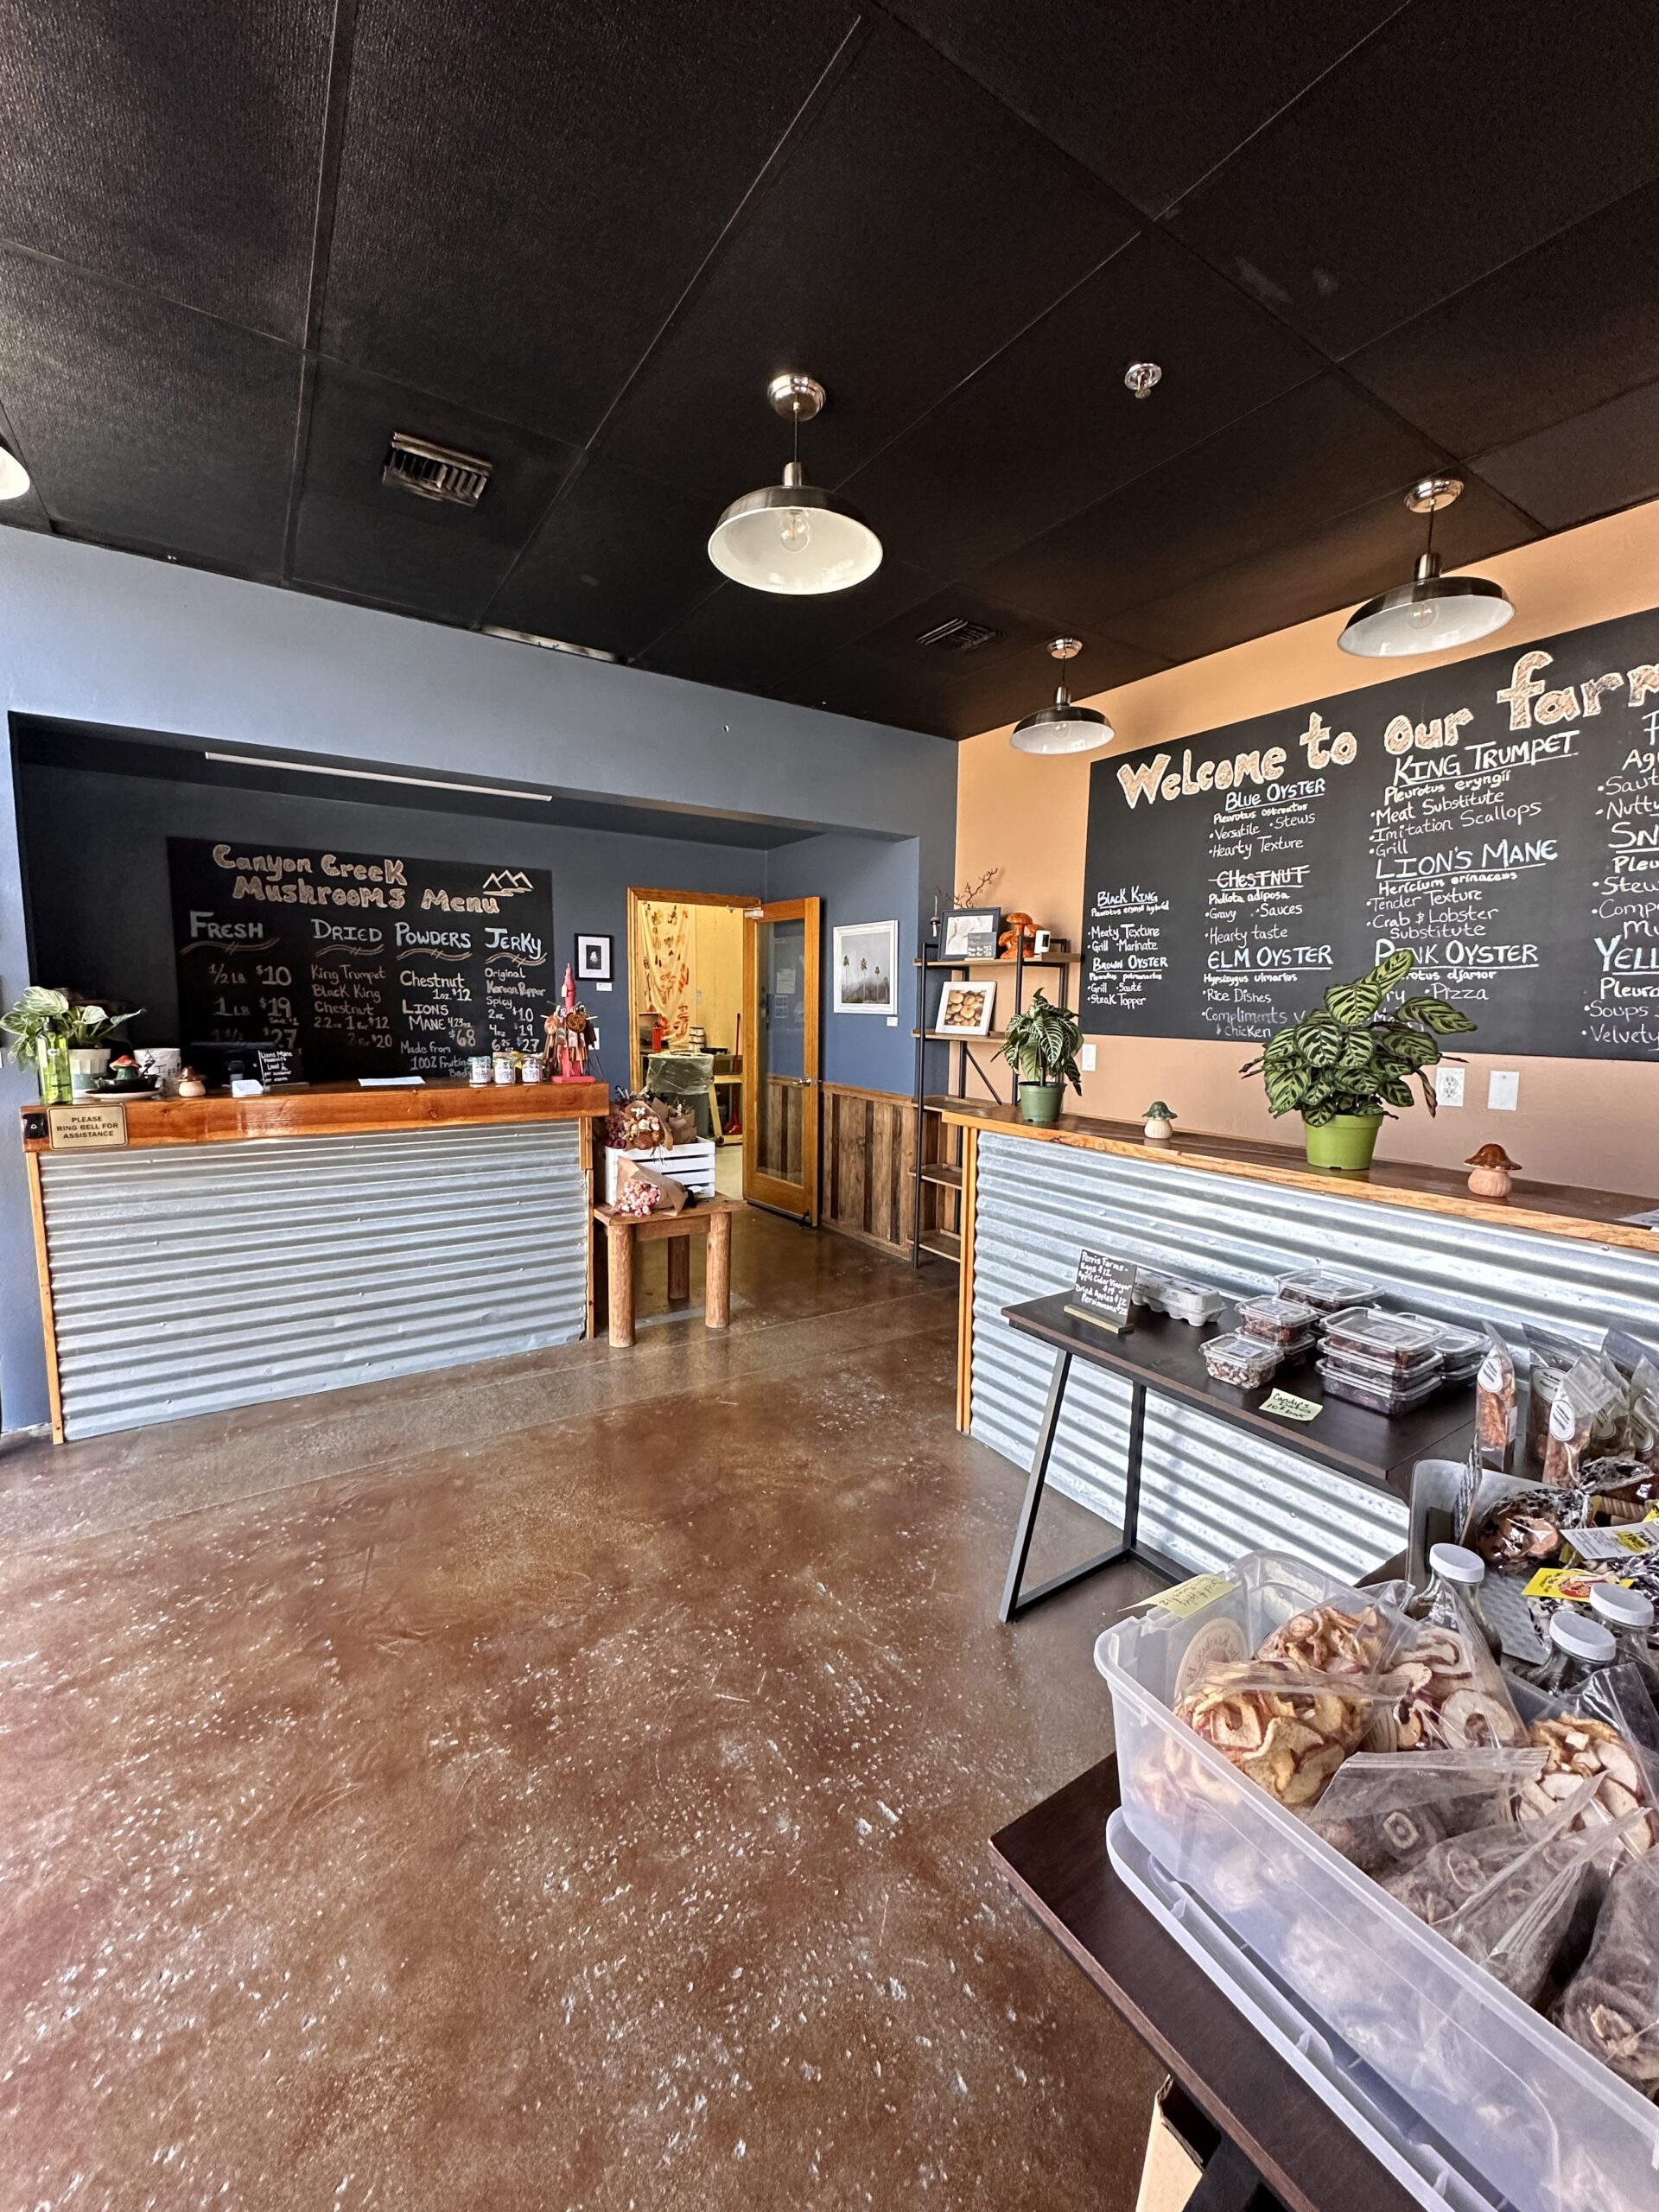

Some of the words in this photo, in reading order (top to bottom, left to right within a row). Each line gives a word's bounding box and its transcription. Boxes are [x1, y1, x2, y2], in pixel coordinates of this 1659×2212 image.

[1116, 747, 1287, 810] Welcome
[1299, 711, 1357, 769] to
[1384, 708, 1474, 755] Our
[1393, 754, 1461, 787] KING
[1465, 730, 1580, 770] TRUMPET
[1267, 778, 1325, 802] OYSTER
[1384, 784, 1445, 806] Pleurotus
[1376, 803, 1415, 826] Meat
[1422, 790, 1504, 815] Substitute
[1274, 813, 1315, 830] Stews
[1372, 817, 1453, 842] Imitation
[1460, 801, 1542, 827] Scallops
[1215, 823, 1261, 841] Versatile
[1213, 840, 1252, 861] Hearty
[1257, 835, 1304, 853] Texture
[1376, 839, 1408, 857] Grill
[213, 843, 313, 881] Canyon
[1376, 845, 1473, 879] LION'S
[1482, 838, 1558, 868] MANE
[421, 888, 500, 913] Menu
[1131, 885, 1158, 902] KING
[1247, 888, 1290, 903] adiposa
[1370, 895, 1422, 912] Tender
[1422, 887, 1483, 906] Texture
[1210, 909, 1236, 922] Gravy
[1259, 903, 1303, 918] Sauces
[1372, 912, 1410, 929] Crab
[1429, 906, 1499, 924] Lobster
[190, 910, 264, 938] FRESH
[311, 918, 382, 942] DRIED
[1091, 925, 1119, 940] Meaty
[1121, 924, 1160, 939] Texture
[1390, 922, 1487, 939] Substitute
[395, 921, 471, 949] POWDERS
[485, 927, 542, 960] JERKY
[1210, 926, 1248, 949] Hearty
[1251, 924, 1288, 940] taste
[1092, 940, 1109, 953] Grill
[1118, 938, 1158, 952] Marinate
[1375, 938, 1439, 967] PNK
[1446, 939, 1539, 963] OYSTER
[1128, 955, 1168, 969] OYSTER
[1207, 947, 1251, 969] ELM
[1256, 944, 1334, 967] OYSTER
[207, 963, 230, 984] 1/2
[256, 964, 292, 986] $10
[311, 963, 339, 985] King
[340, 964, 387, 984] Trumpet
[400, 969, 466, 988] Chestnut
[485, 967, 526, 982] Original
[353, 984, 381, 1002] King
[452, 988, 472, 1001] $12
[486, 980, 518, 995] Korean
[518, 982, 546, 997] Pepper
[1091, 982, 1107, 993] Grill
[1206, 988, 1230, 1001] Rice
[1234, 988, 1272, 1003] Dishes
[1431, 982, 1489, 1000] Pizza
[259, 996, 292, 1018] $19
[315, 1000, 374, 1015] Chestnut
[486, 995, 512, 1009] Spicy
[1117, 993, 1147, 1009] Topper
[488, 1008, 505, 1020] 2oz
[512, 1006, 534, 1022] $10
[1205, 1007, 1287, 1026] Compliments
[1589, 1001, 1649, 1023] Soups
[369, 1016, 391, 1029] $12
[409, 1015, 446, 1032] MANE
[372, 1034, 392, 1048] $20
[448, 1028, 476, 1047] $68
[517, 1036, 540, 1052] $27
[400, 1040, 428, 1054] Made
[410, 1055, 437, 1071] 100%
[439, 1055, 469, 1069] Fruitin
